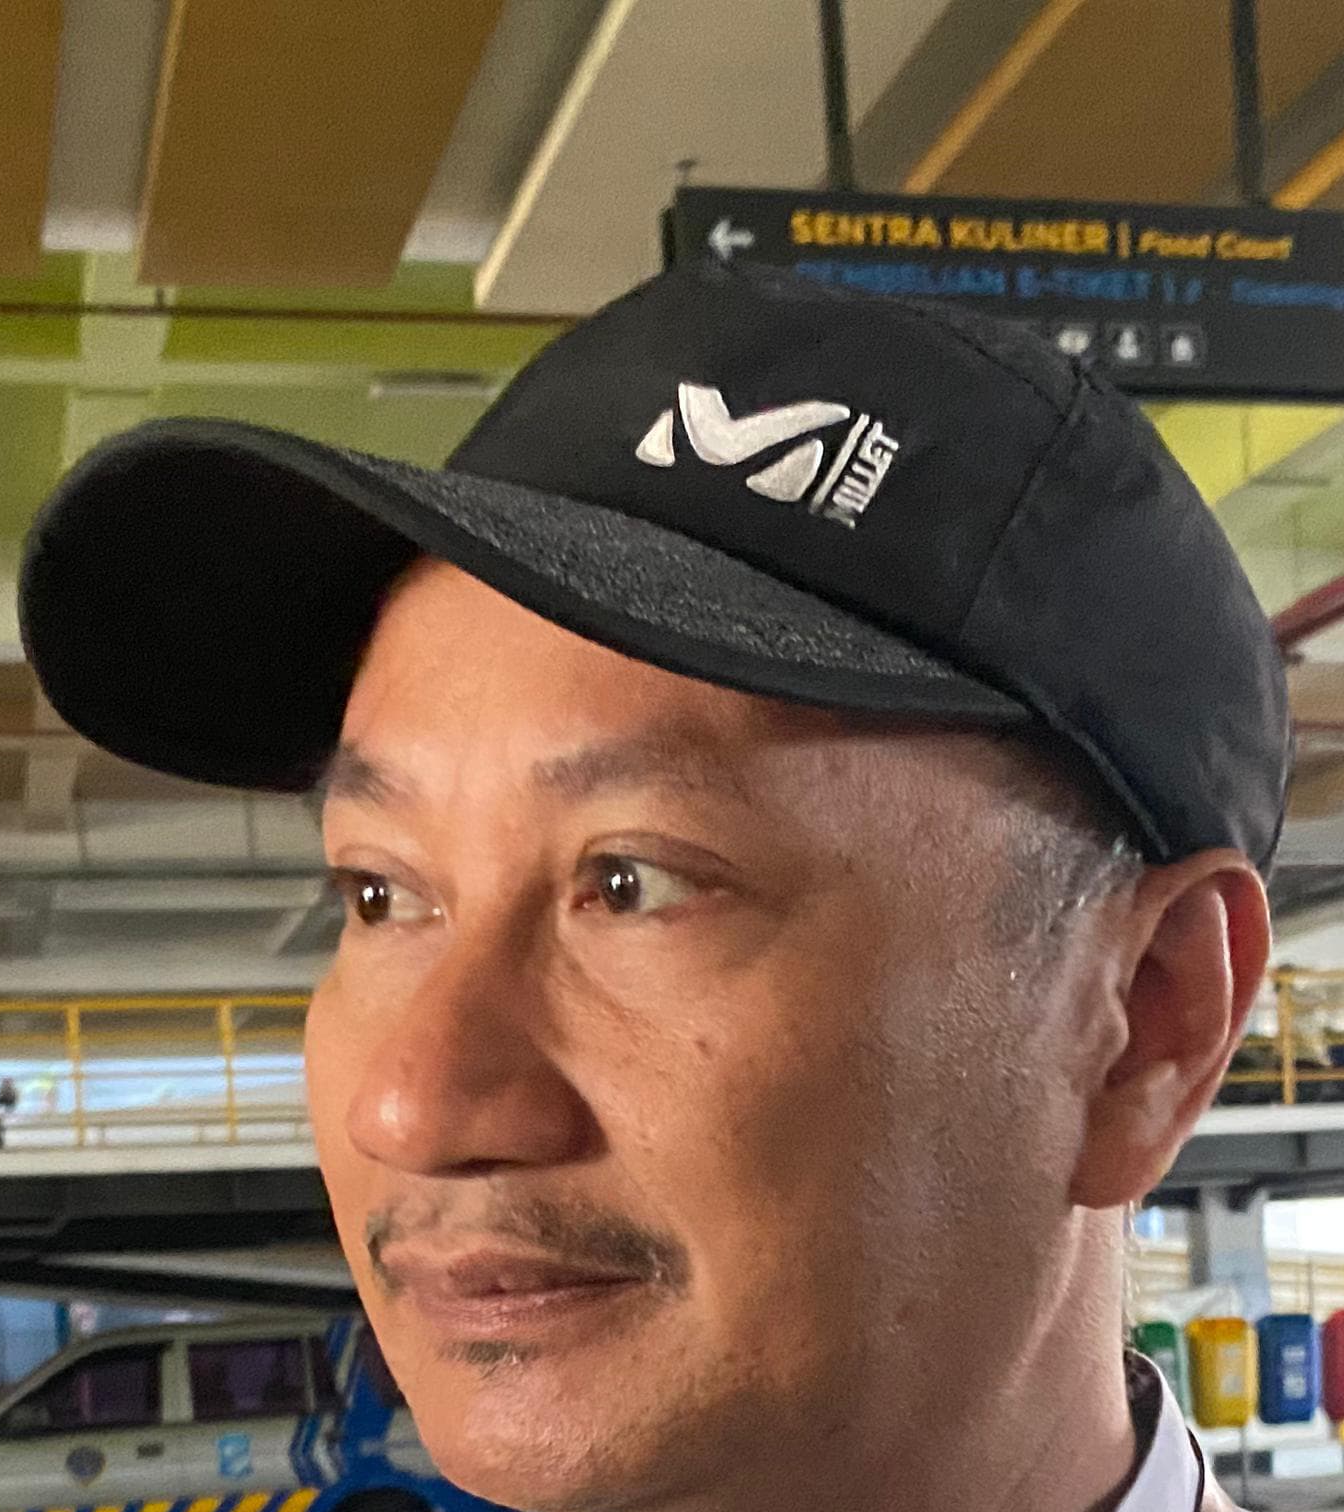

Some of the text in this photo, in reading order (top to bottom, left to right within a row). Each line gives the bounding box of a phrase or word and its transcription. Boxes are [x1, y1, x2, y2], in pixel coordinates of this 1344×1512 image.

[790, 210, 1294, 261] SENTRA KULINER Food Court
[822, 419, 900, 530] MILLET
